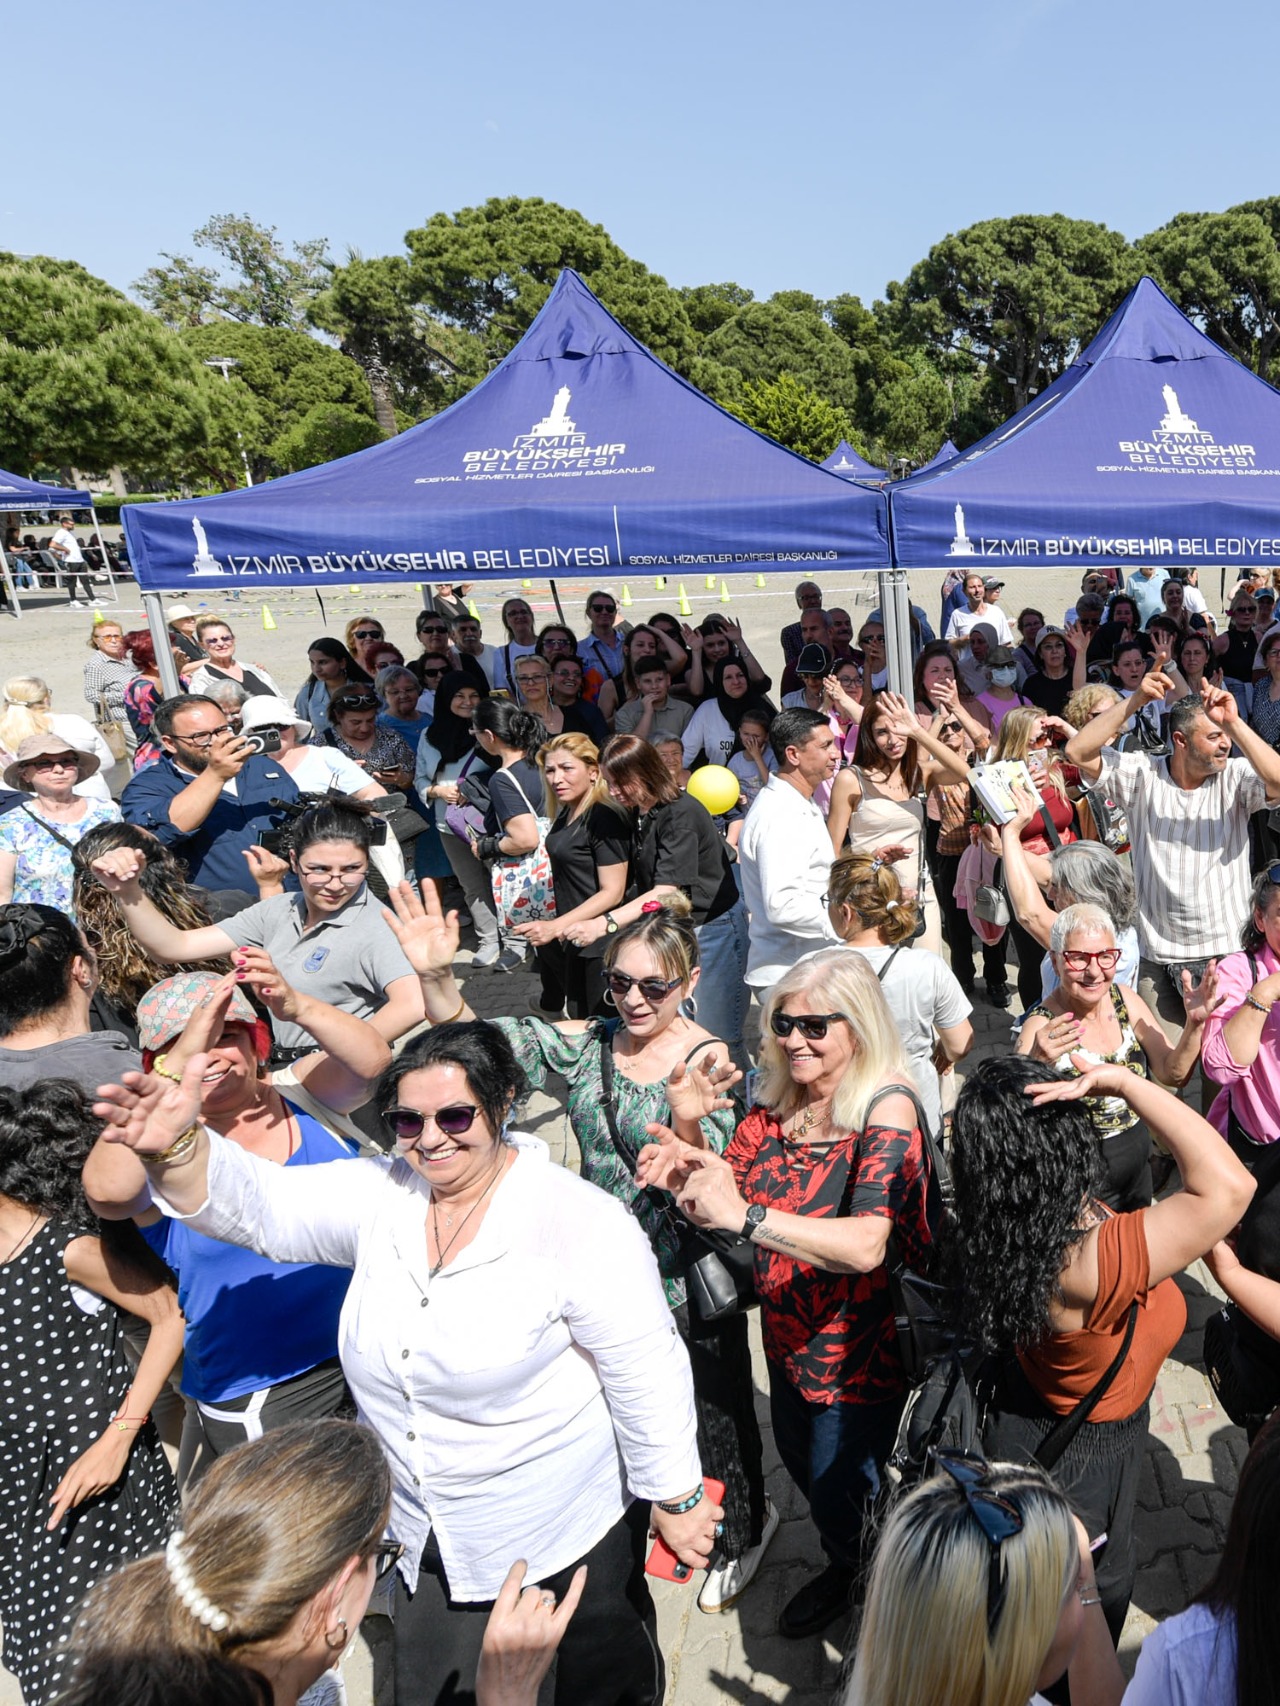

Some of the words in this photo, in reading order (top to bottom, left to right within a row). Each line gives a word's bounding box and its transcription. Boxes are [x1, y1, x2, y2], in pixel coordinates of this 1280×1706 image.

[512, 435, 586, 448] İZMİR
[1152, 432, 1215, 444] İZMİR
[462, 443, 626, 463] BÜYÜKŞEHİR
[1118, 439, 1256, 456] BÜYÜKŞEHİR
[464, 456, 616, 473] BELEDİYESİ
[1128, 454, 1255, 467] BELEDİYESİ
[414, 475, 462, 484] SOSYAL
[465, 472, 534, 481] HİZMETLER
[536, 470, 582, 479] DAİRESİ
[584, 465, 655, 477] BAŞKANLIĞI
[1138, 465, 1195, 475] HİZMETLER
[980, 537, 1039, 556] İZMİR
[1044, 536, 1173, 557] BÜYÜKŞEHİR
[227, 552, 304, 575] İZMİR
[307, 549, 468, 574] BÜYÜKŞEHİR
[473, 545, 609, 570] BELEDİYESİ
[629, 555, 672, 565] SOSYAL
[673, 553, 733, 564] HİZMETLER
[735, 552, 775, 563] DAİRESİ
[777, 550, 838, 562] BAŞKANLIĞI
